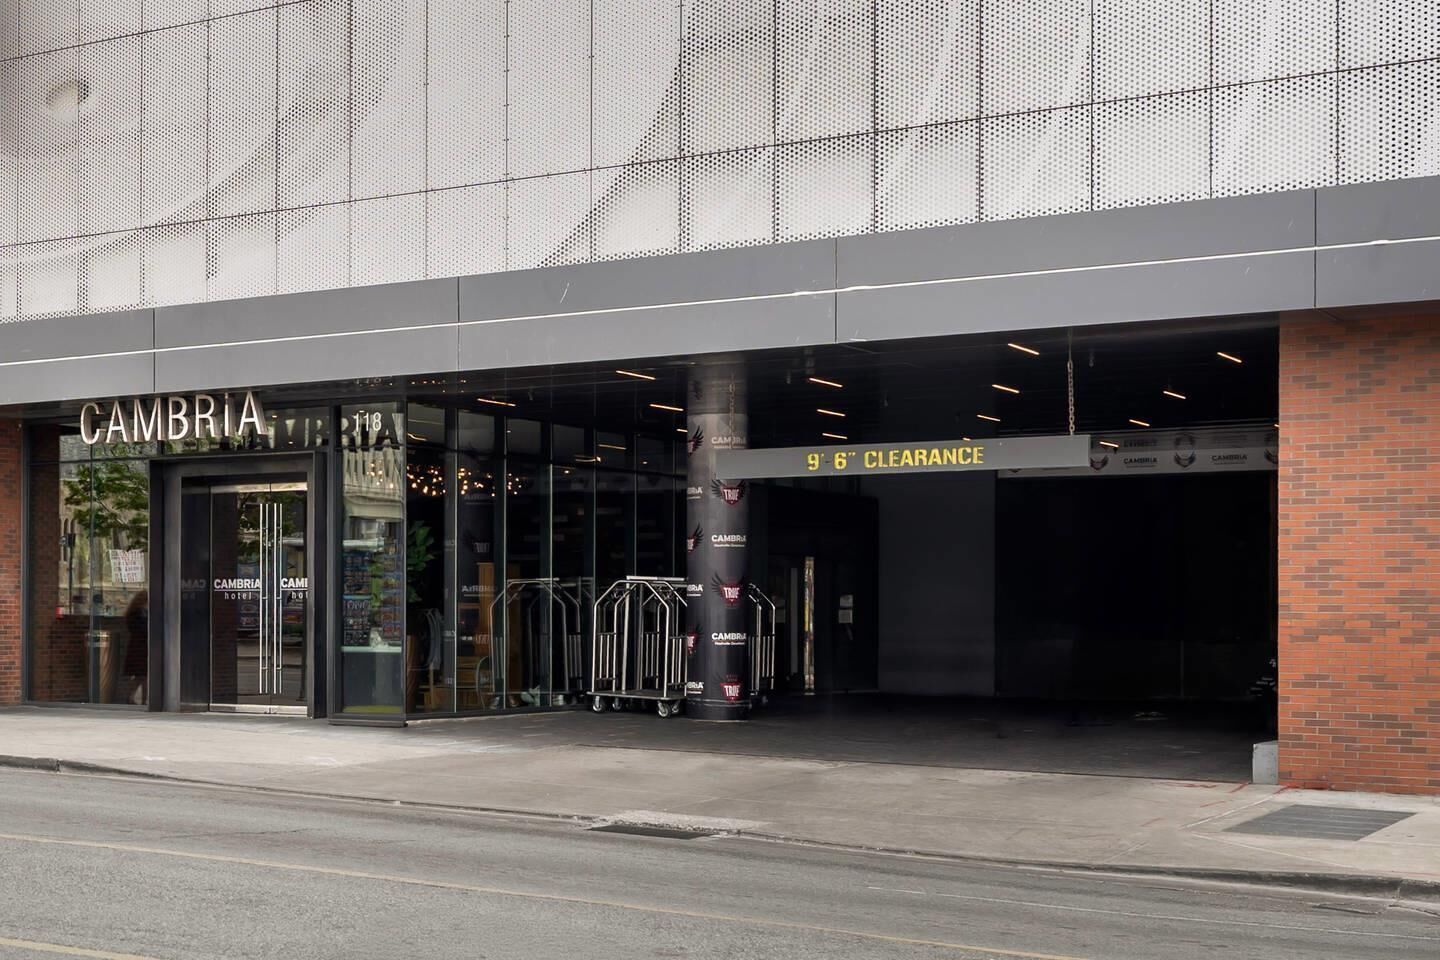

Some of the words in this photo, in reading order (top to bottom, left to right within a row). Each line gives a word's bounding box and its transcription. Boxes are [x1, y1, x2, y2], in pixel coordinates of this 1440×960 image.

[352, 411, 382, 433] 118
[864, 446, 985, 470] CLEARANCE
[224, 591, 253, 601] hotel
